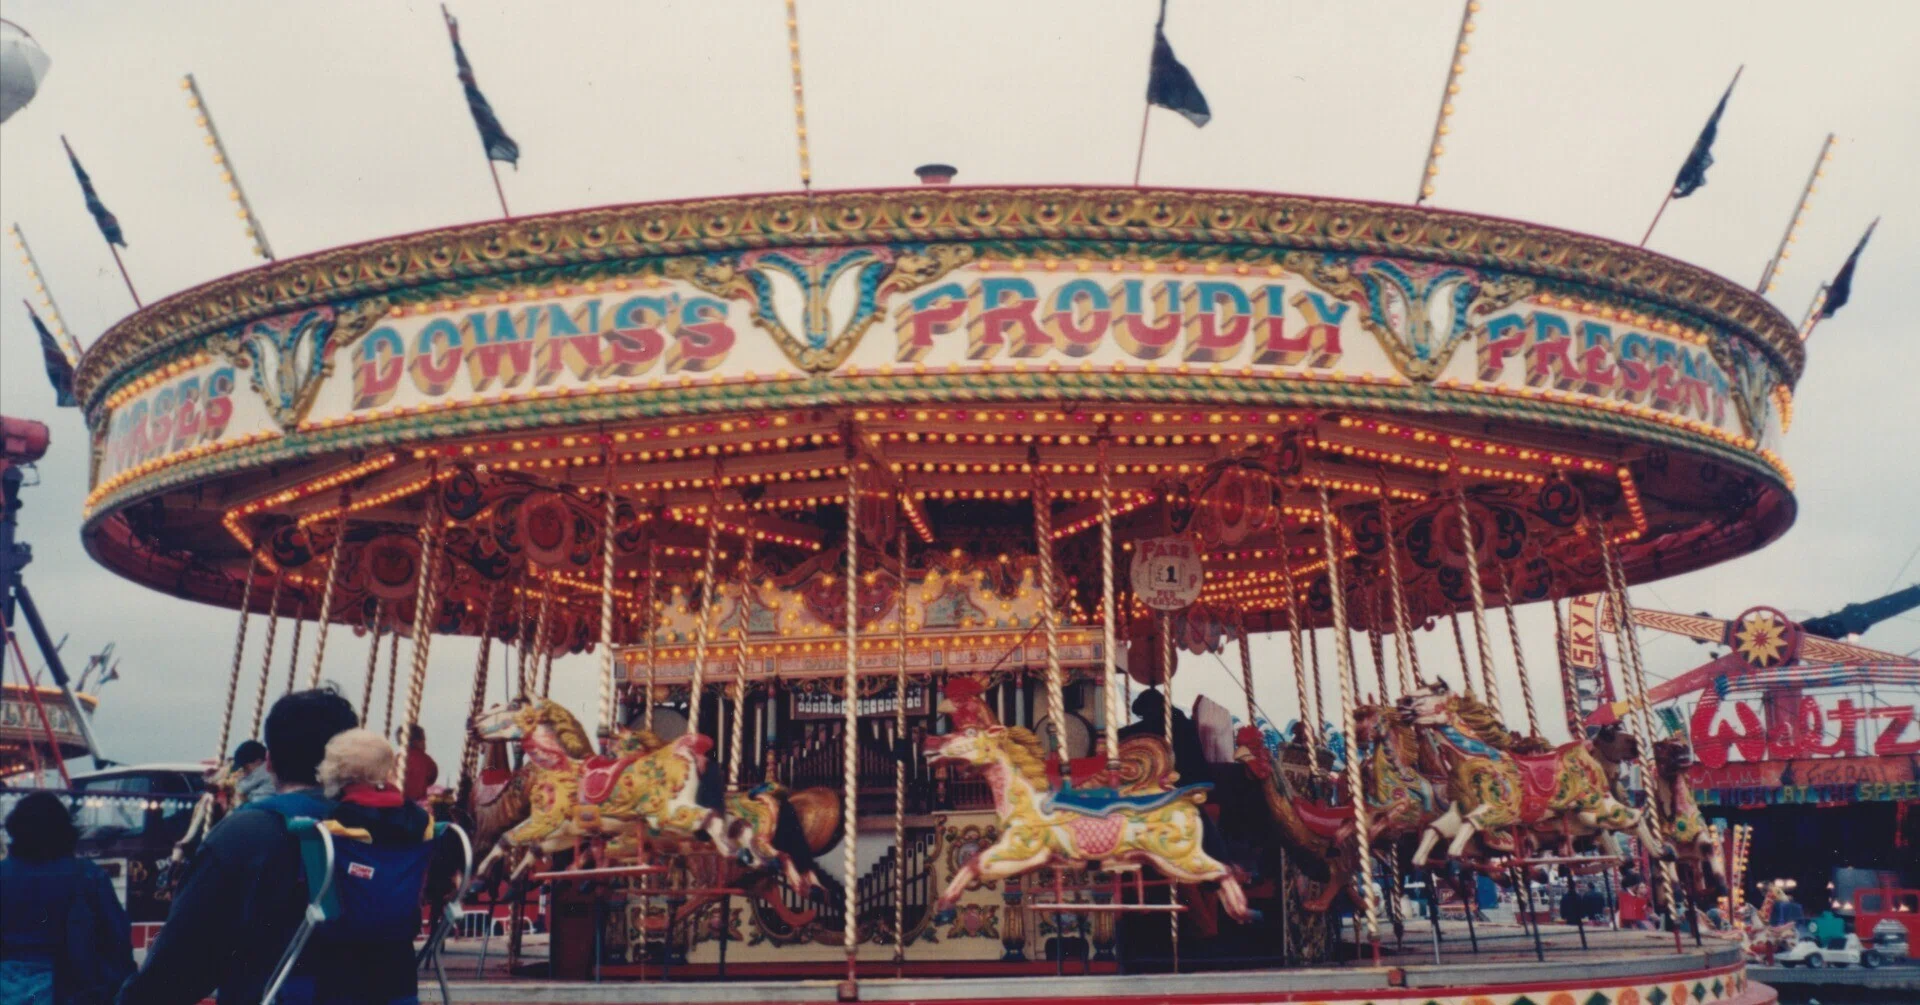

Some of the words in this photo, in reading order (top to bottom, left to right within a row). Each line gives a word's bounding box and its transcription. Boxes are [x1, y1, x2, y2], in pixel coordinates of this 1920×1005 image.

[351, 293, 736, 409] DOWNS'S
[895, 277, 1350, 368] PROUDLY
[1477, 311, 1730, 427] PRESENT
[1141, 541, 1190, 564] FARE
[1572, 612, 1594, 664] SKY
[1784, 784, 1809, 802] AT
